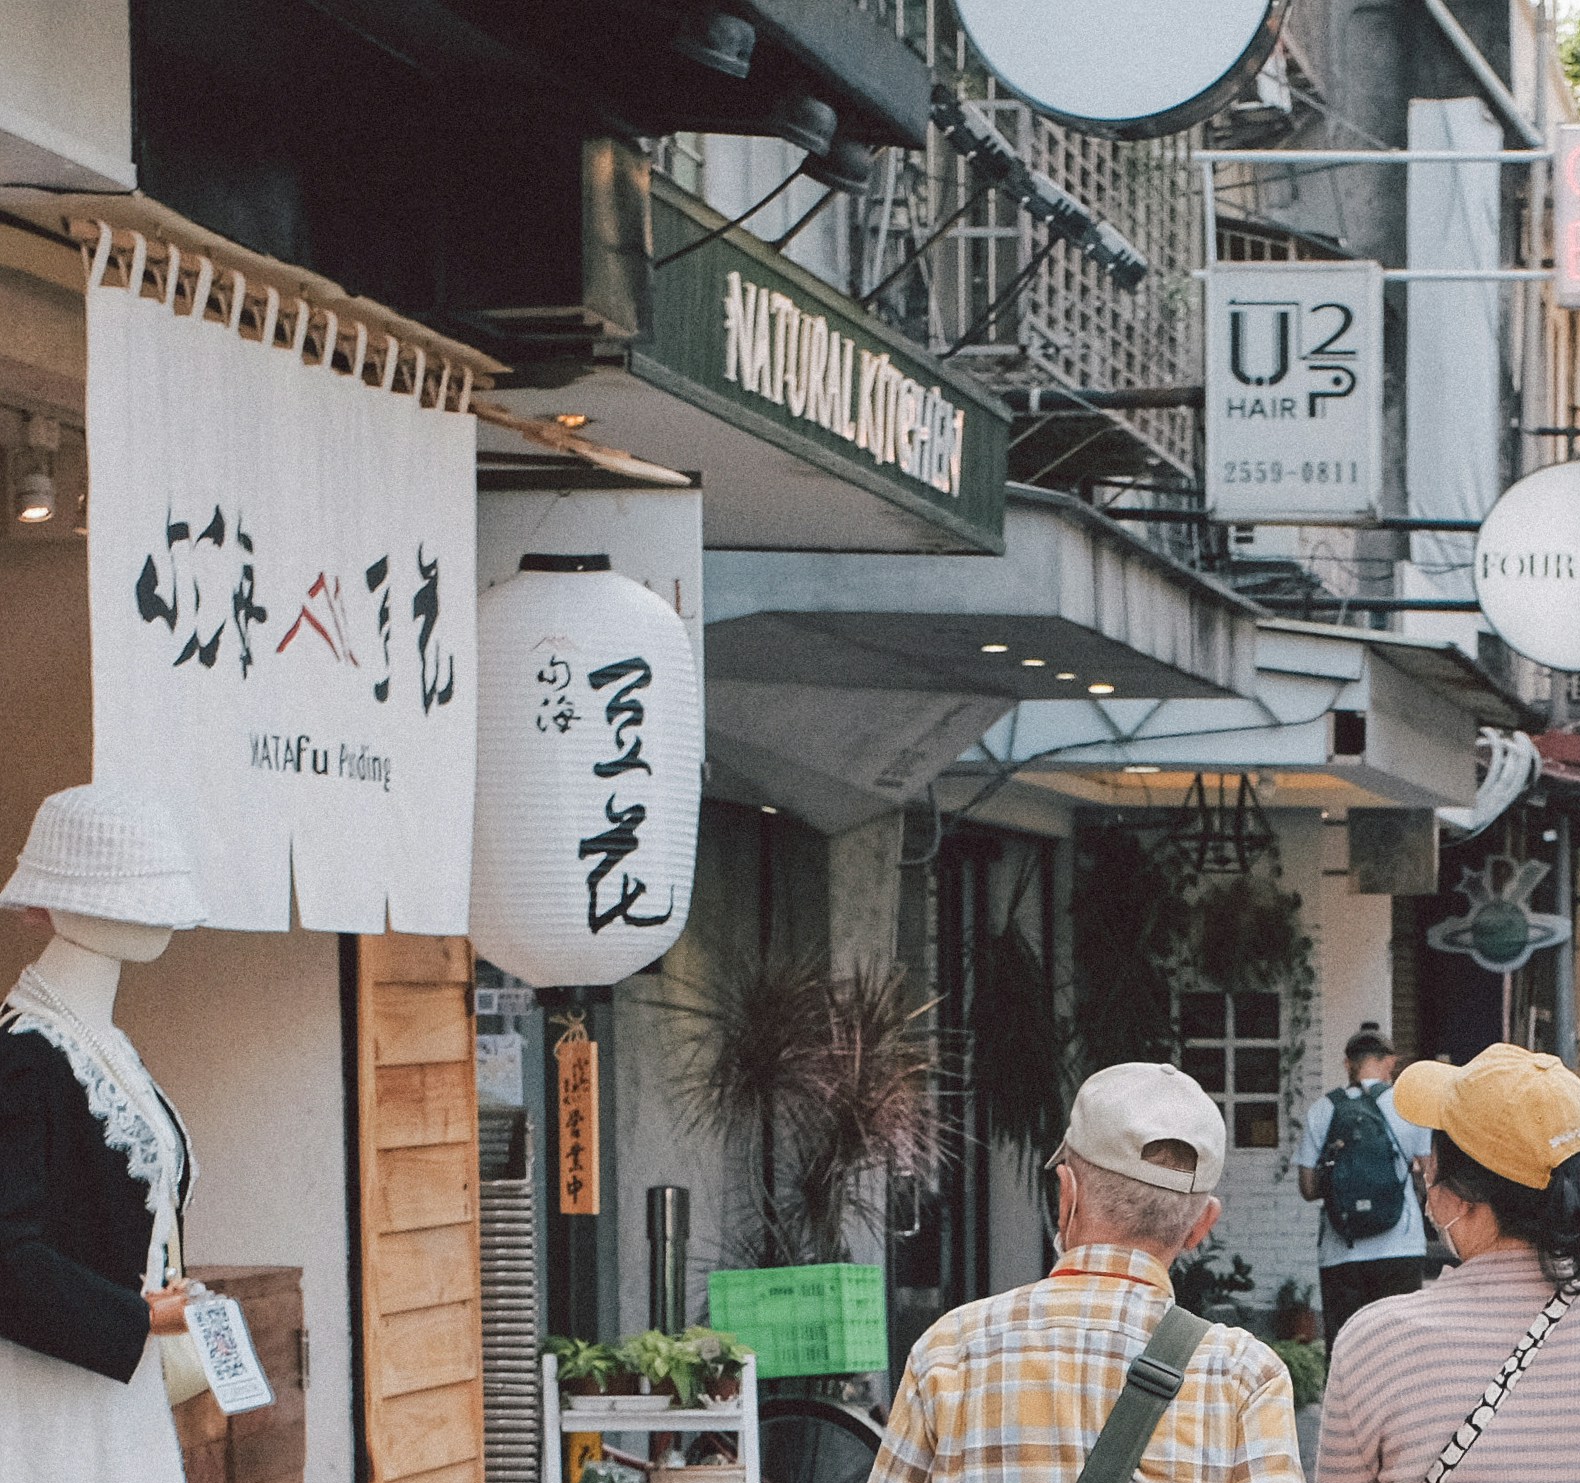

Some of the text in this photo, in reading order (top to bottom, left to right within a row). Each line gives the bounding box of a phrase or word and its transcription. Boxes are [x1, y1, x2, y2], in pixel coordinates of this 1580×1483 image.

[724, 271, 855, 441] NATURAL
[1227, 398, 1298, 418] HAIR
[1482, 552, 1575, 579] FOUR
